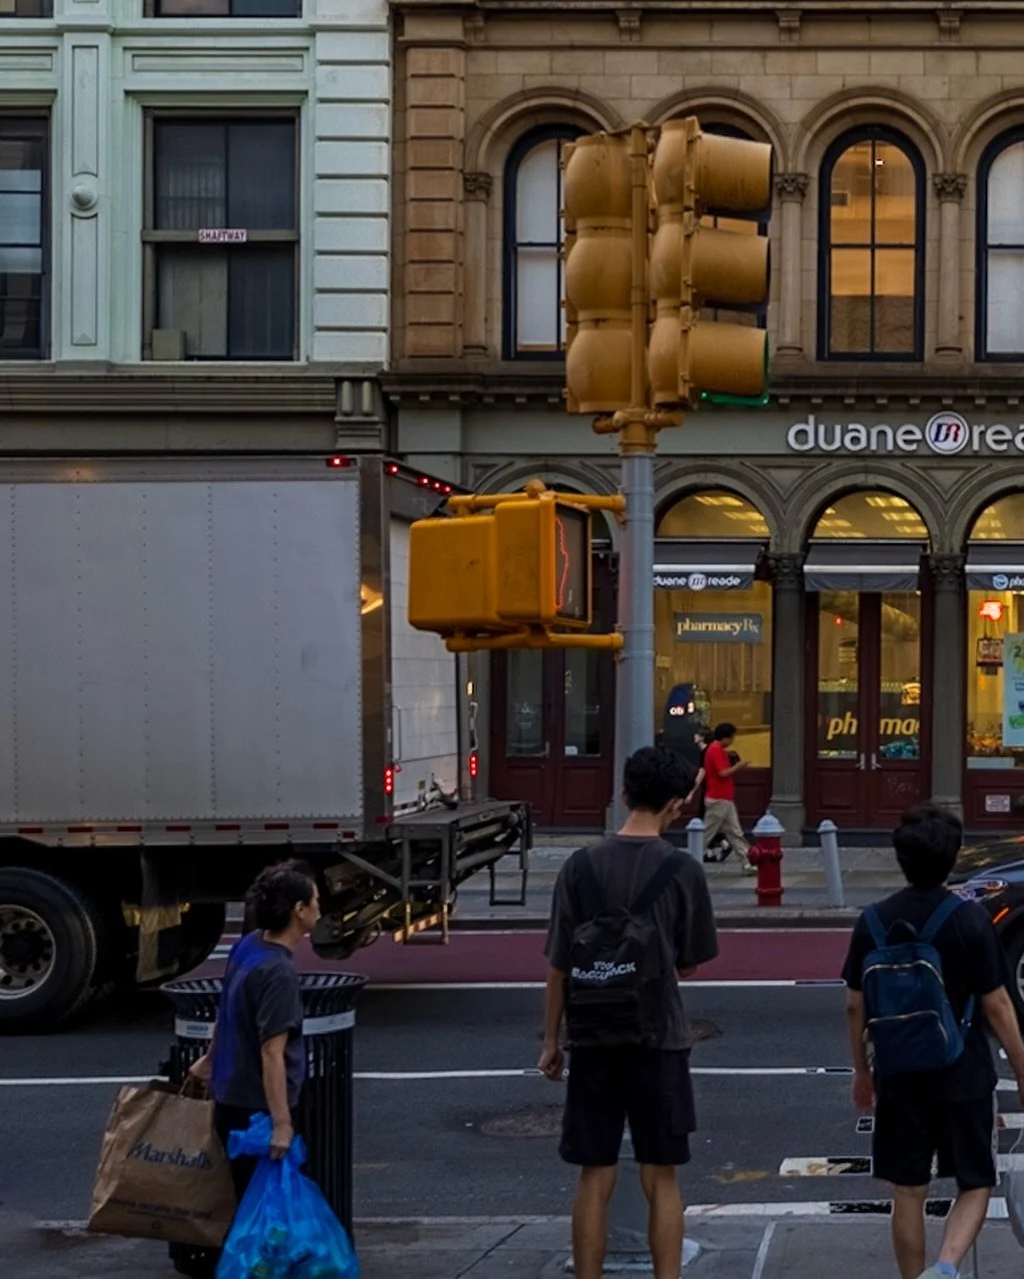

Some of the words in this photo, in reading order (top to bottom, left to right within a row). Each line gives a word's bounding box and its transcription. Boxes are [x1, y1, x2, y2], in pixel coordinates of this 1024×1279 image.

[199, 230, 246, 241] SHAFTWAY
[787, 414, 923, 452] duane
[707, 575, 741, 586] reade
[677, 617, 742, 636] pharmacy
[127, 1141, 213, 1169] Marshalls
